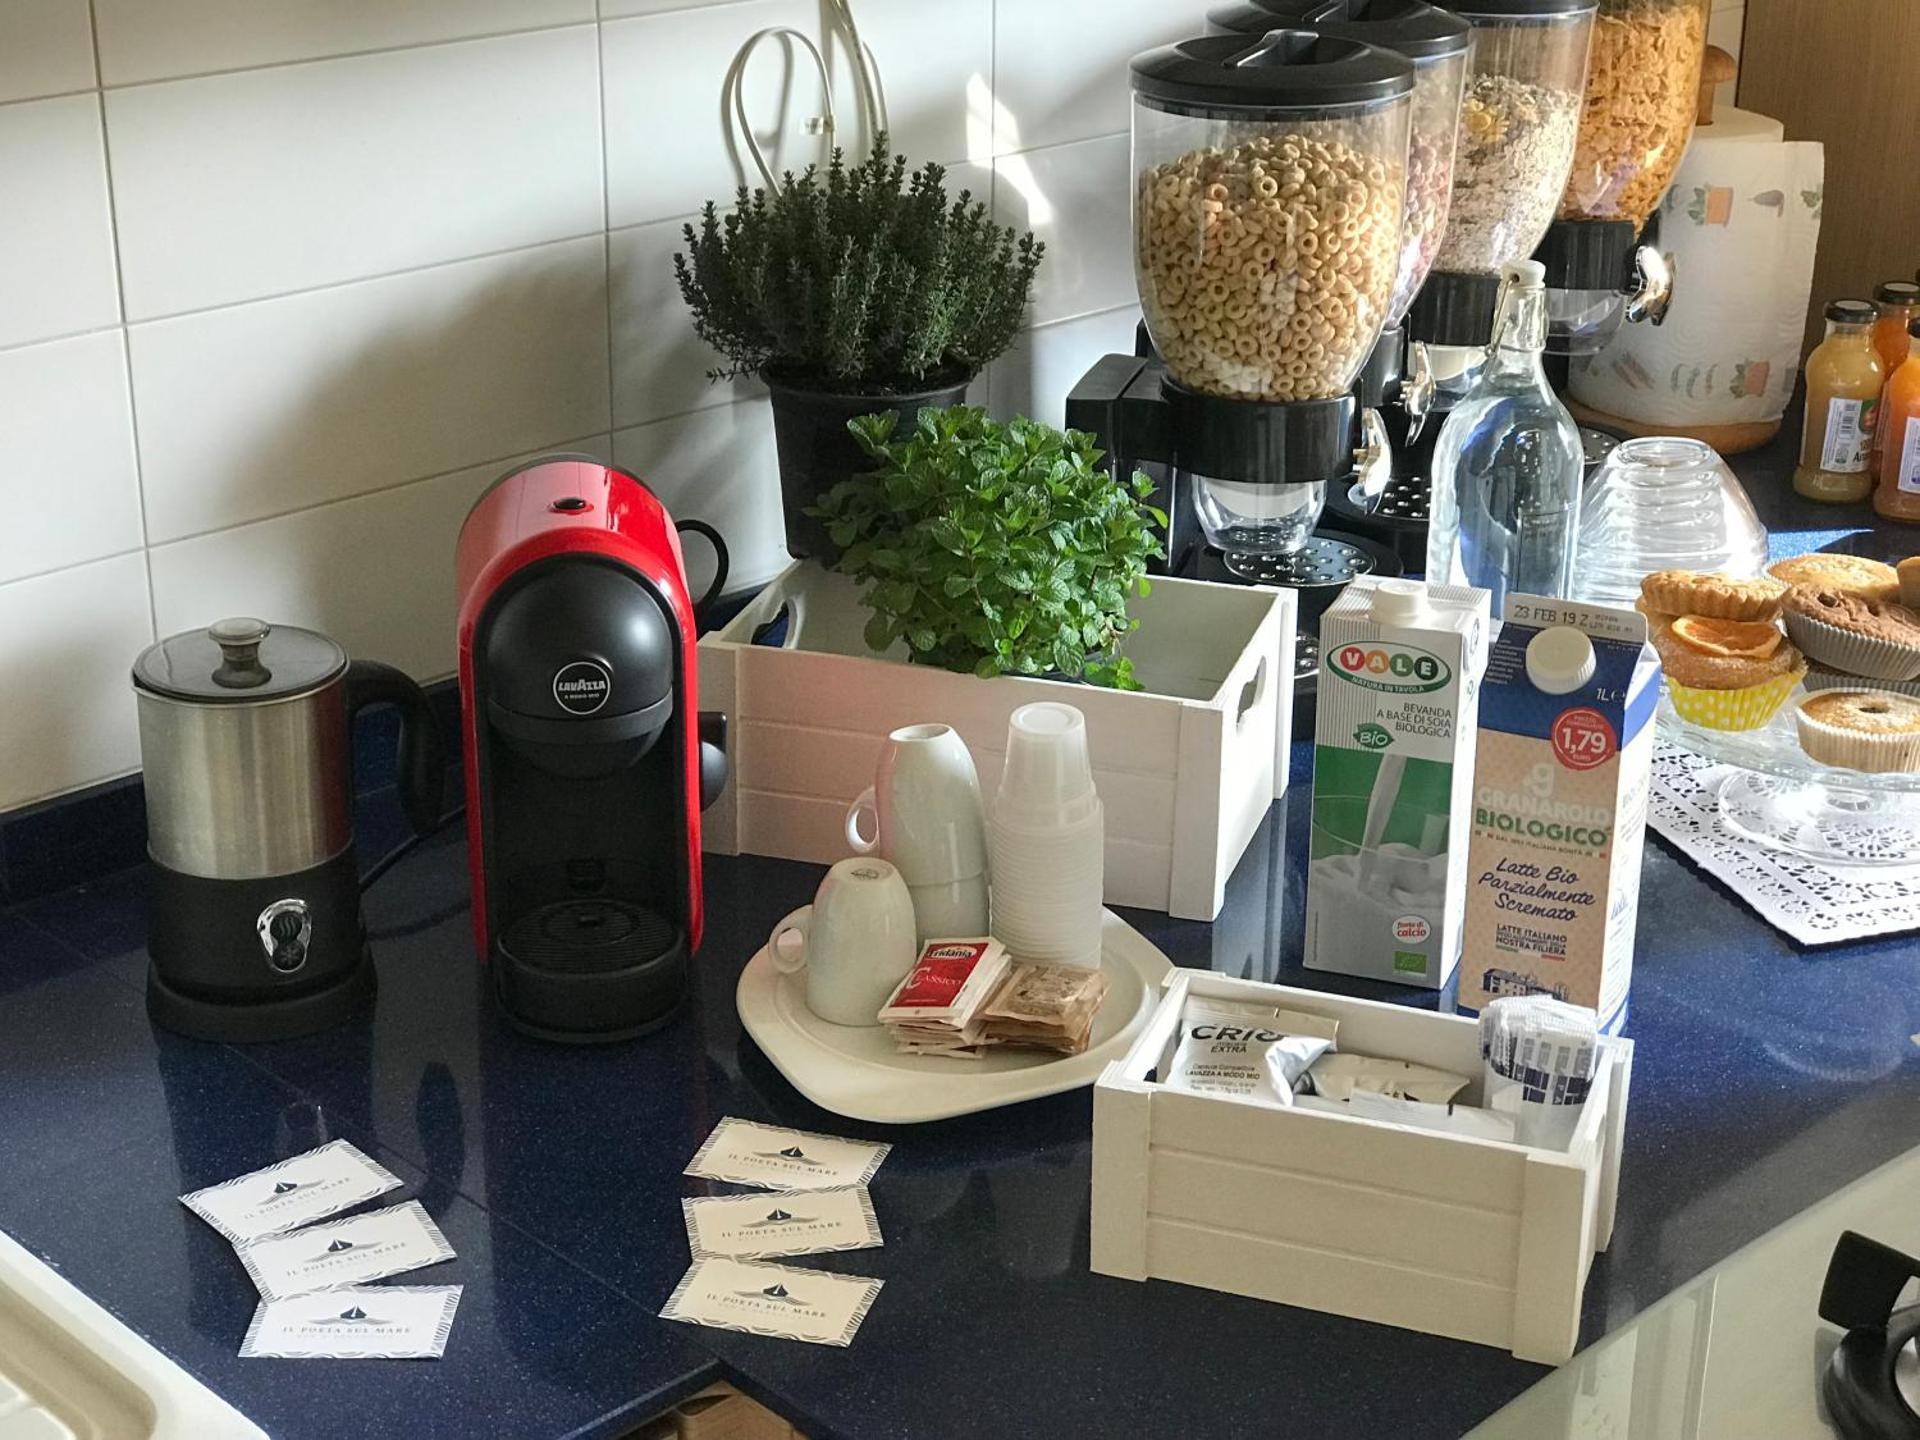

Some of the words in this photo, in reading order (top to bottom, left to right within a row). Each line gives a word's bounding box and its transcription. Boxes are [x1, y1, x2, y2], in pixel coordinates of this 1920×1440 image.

[1513, 604, 1530, 619] 23
[1534, 608, 1557, 622] FEB
[1562, 611, 1577, 625] 19
[1343, 650, 1434, 678] VALE
[558, 679, 606, 691] LAVAZZA
[1351, 676, 1384, 691] NATURA
[1384, 684, 1393, 693] IN
[1394, 684, 1425, 693] TAVOLA
[1376, 708, 1385, 719] A
[1386, 710, 1412, 723] BASE
[1413, 713, 1425, 725] DI
[1427, 716, 1452, 729] SOIA
[1403, 702, 1452, 719] BEVANDA
[1395, 721, 1451, 739] BIOLOGICA
[1562, 727, 1607, 754] 1,79
[1478, 786, 1610, 826] GRANAROLO
[1475, 808, 1608, 847] BIOLOGICO
[1496, 857, 1541, 879] Latte
[1545, 866, 1580, 885] Bio
[1478, 871, 1597, 906] Parzialmente
[1494, 892, 1578, 921] Scremato
[1397, 927, 1427, 938] calcio
[1496, 922, 1523, 936] LATTE
[1524, 928, 1568, 944] ITALIANO
[1495, 935, 1532, 951] NOSTRA
[1532, 942, 1566, 956] FILIERA
[1210, 1045, 1248, 1054] EXTRA
[1185, 1069, 1216, 1077] LAVAZZA
[1223, 1071, 1246, 1079] MODO
[1246, 1073, 1260, 1081] MIO
